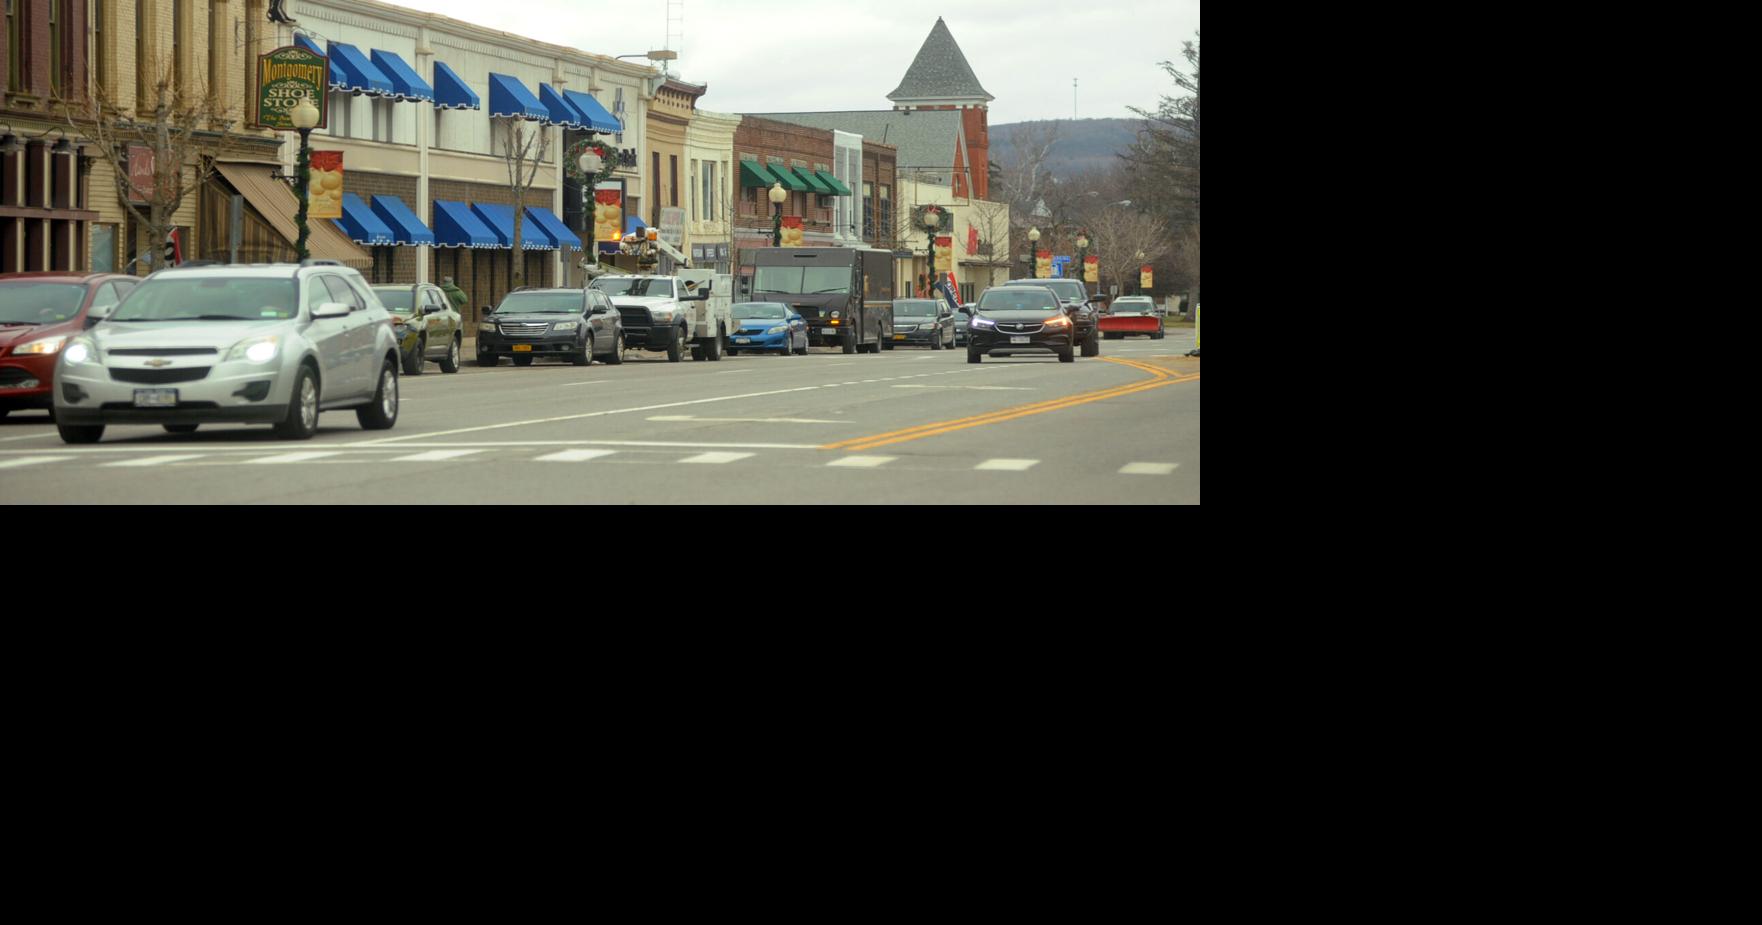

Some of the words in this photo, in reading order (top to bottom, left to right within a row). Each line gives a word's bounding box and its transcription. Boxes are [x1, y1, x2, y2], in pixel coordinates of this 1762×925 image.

[263, 59, 323, 91] Montgomery
[268, 88, 315, 98] SHOE
[263, 98, 320, 109] STOE
